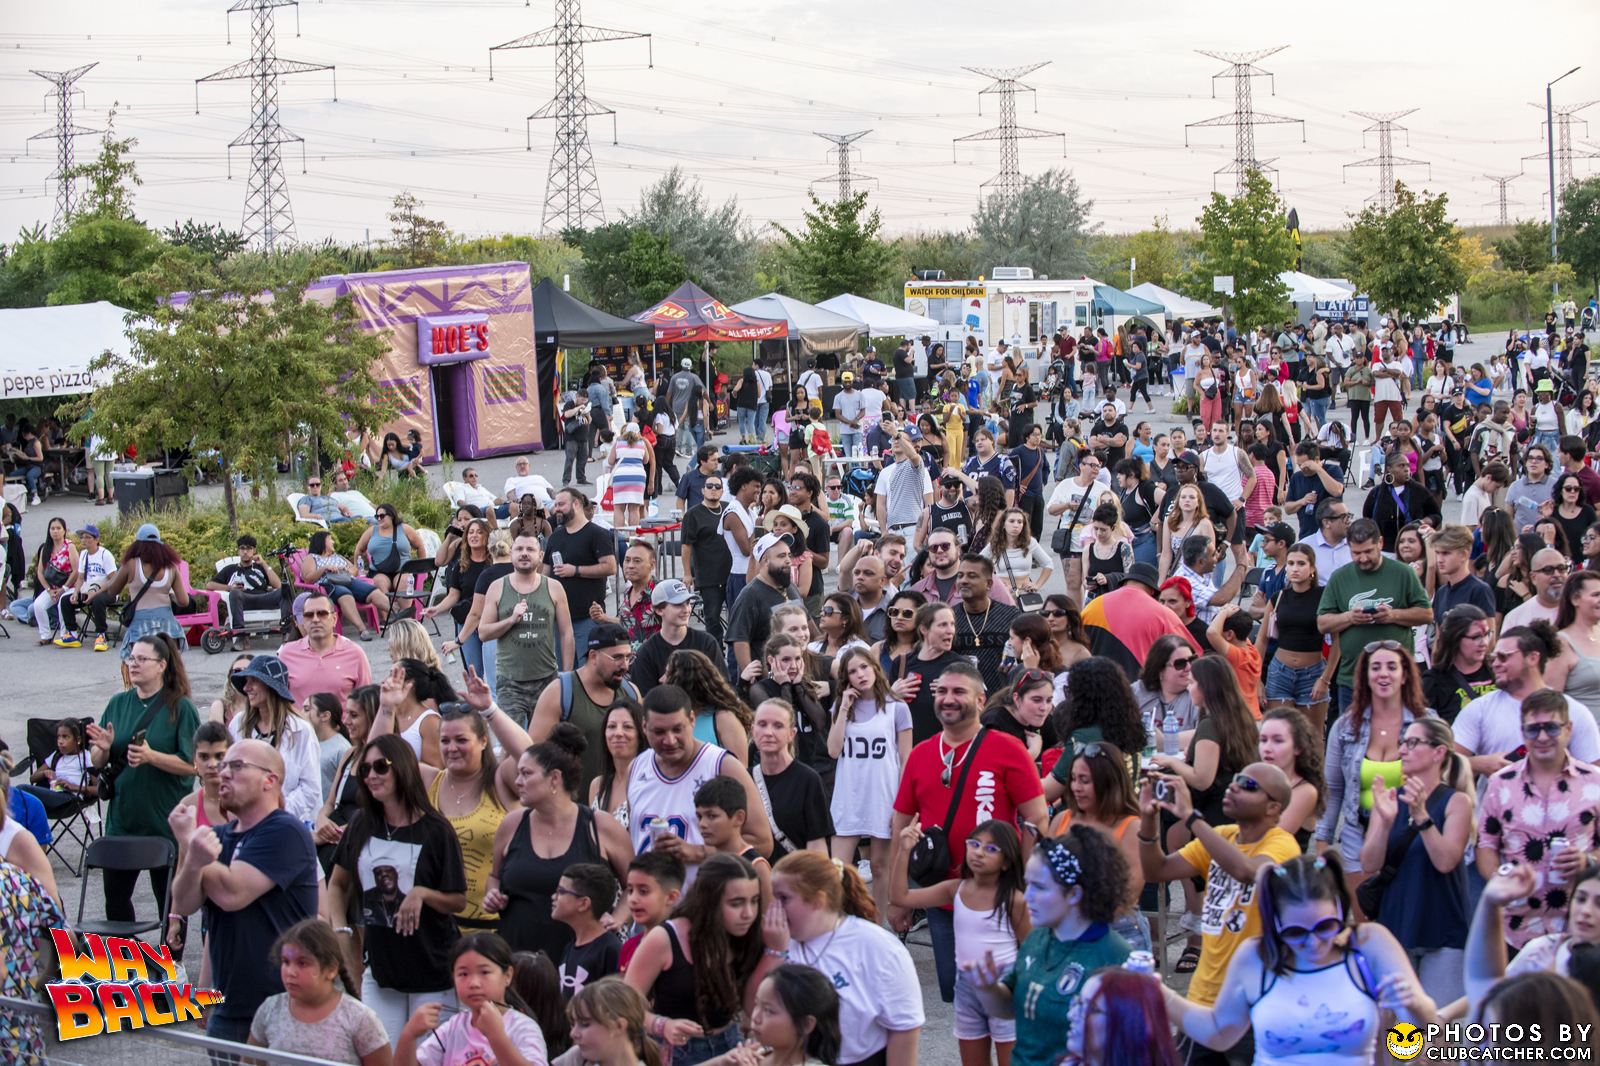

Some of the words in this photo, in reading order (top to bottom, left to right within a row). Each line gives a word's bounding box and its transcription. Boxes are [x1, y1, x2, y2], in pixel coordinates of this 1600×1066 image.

[951, 288, 984, 297] CHILDREN
[1328, 300, 1357, 311] ATM
[728, 330, 743, 338] ALL
[742, 329, 756, 338] THE
[432, 323, 489, 355] MOE'S
[3, 375, 45, 396] pepe
[49, 368, 92, 393] pizza
[523, 612, 533, 621] 87
